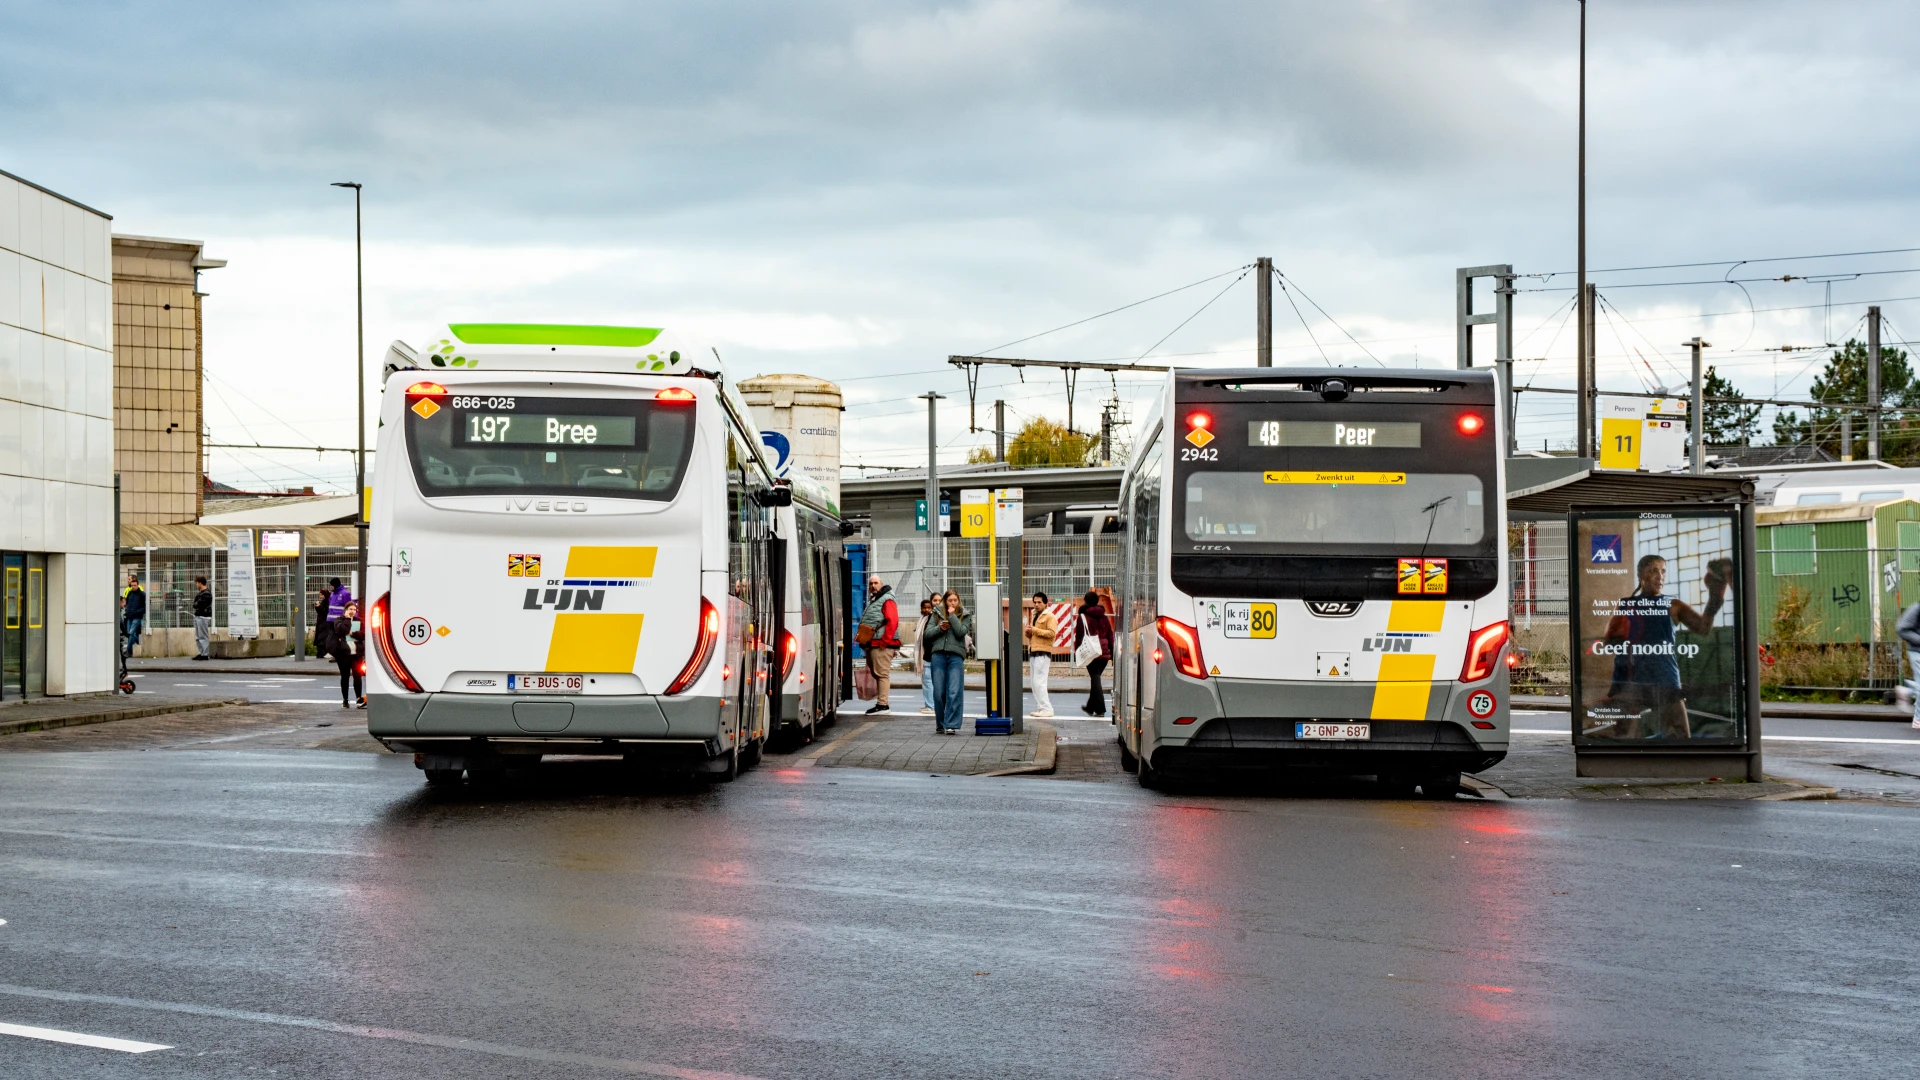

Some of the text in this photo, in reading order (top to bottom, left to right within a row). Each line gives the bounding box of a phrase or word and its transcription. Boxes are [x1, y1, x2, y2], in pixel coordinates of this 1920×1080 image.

[452, 396, 516, 410] 666-025
[470, 416, 597, 444] 197 Bree
[1259, 421, 1376, 446] 48 Peer
[1614, 435, 1632, 453] 11
[1180, 448, 1219, 461] 2942
[1315, 473, 1355, 482] Zwenkt uit
[505, 499, 588, 513] IVECO
[967, 514, 984, 527] 10
[1591, 548, 1617, 562] AXA
[1586, 567, 1628, 576] Verzekeringen
[1314, 602, 1352, 613] VDL
[1592, 599, 1609, 607] Aan
[1611, 599, 1626, 607] wie
[1637, 598, 1655, 607] elke
[1656, 598, 1672, 608] dag
[1227, 610, 1249, 620] Ik rij
[1636, 608, 1668, 616] vechten
[1227, 623, 1249, 631] max
[1251, 610, 1275, 631] 80
[409, 624, 425, 638] 85
[1592, 640, 1699, 658] Geef nooit op
[1474, 696, 1490, 708] 75
[1303, 726, 1368, 737] 2-GNP-687
